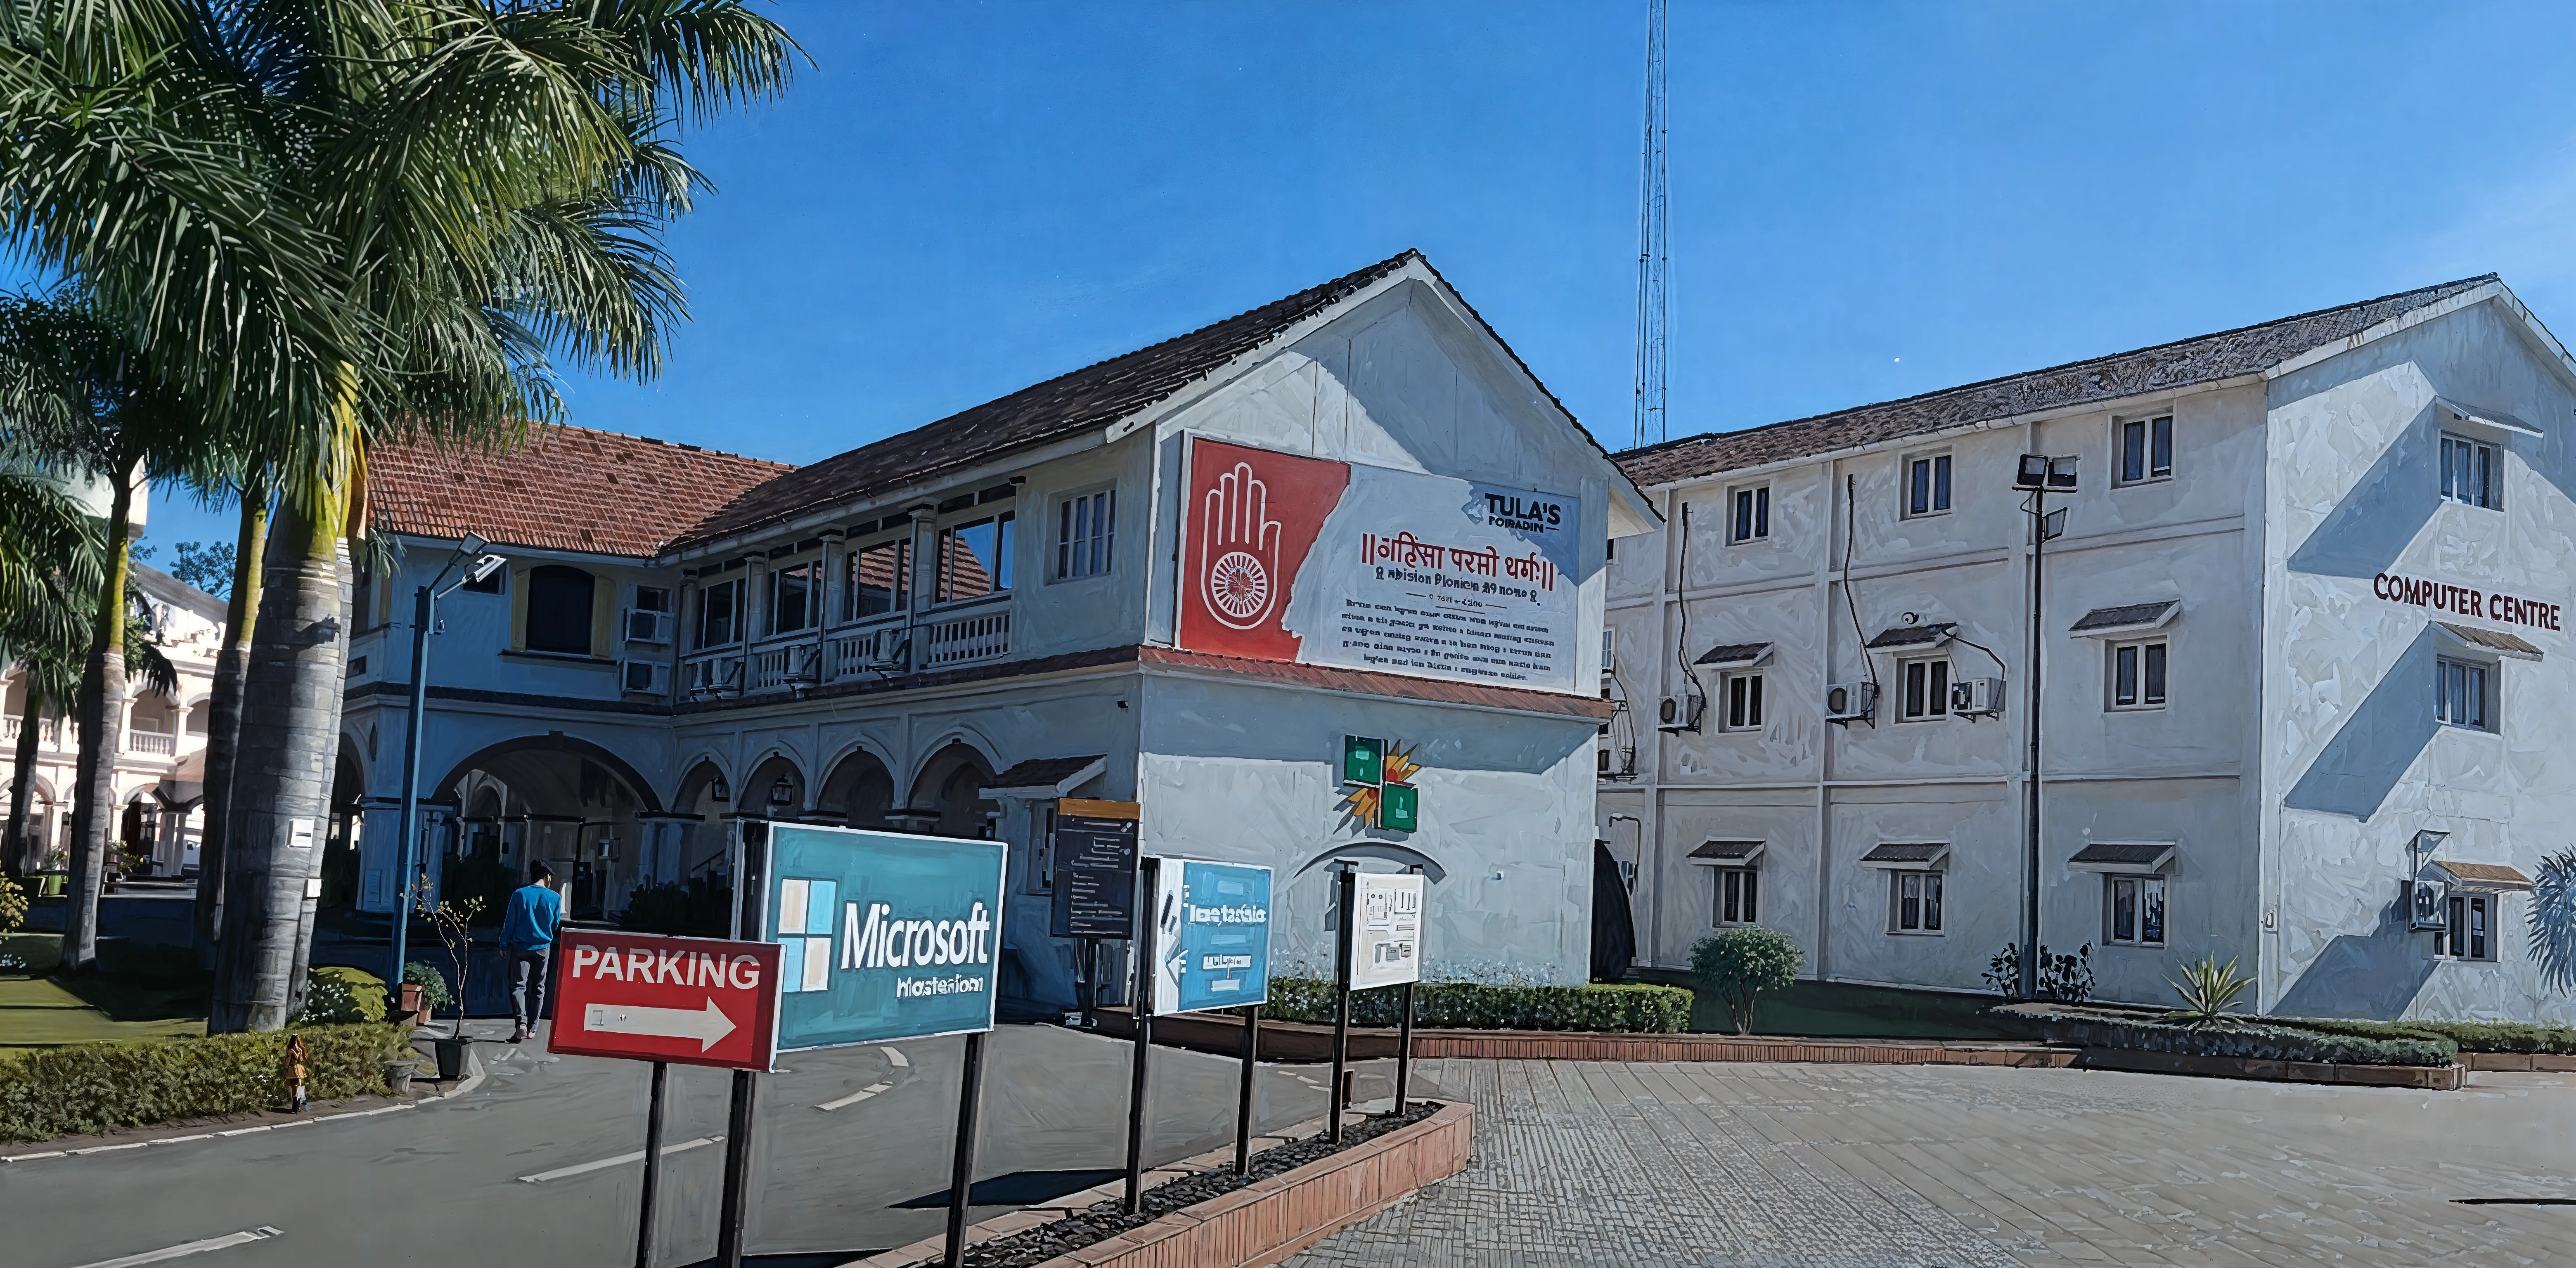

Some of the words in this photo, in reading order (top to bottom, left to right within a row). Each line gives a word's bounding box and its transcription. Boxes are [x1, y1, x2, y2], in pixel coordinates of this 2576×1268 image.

[1485, 493, 1561, 525] TULA'S
[2373, 572, 2483, 617] COMPUTER
[2489, 594, 2560, 631] CENTRE
[841, 902, 990, 969] Microsoft
[572, 944, 760, 990] PARKING
